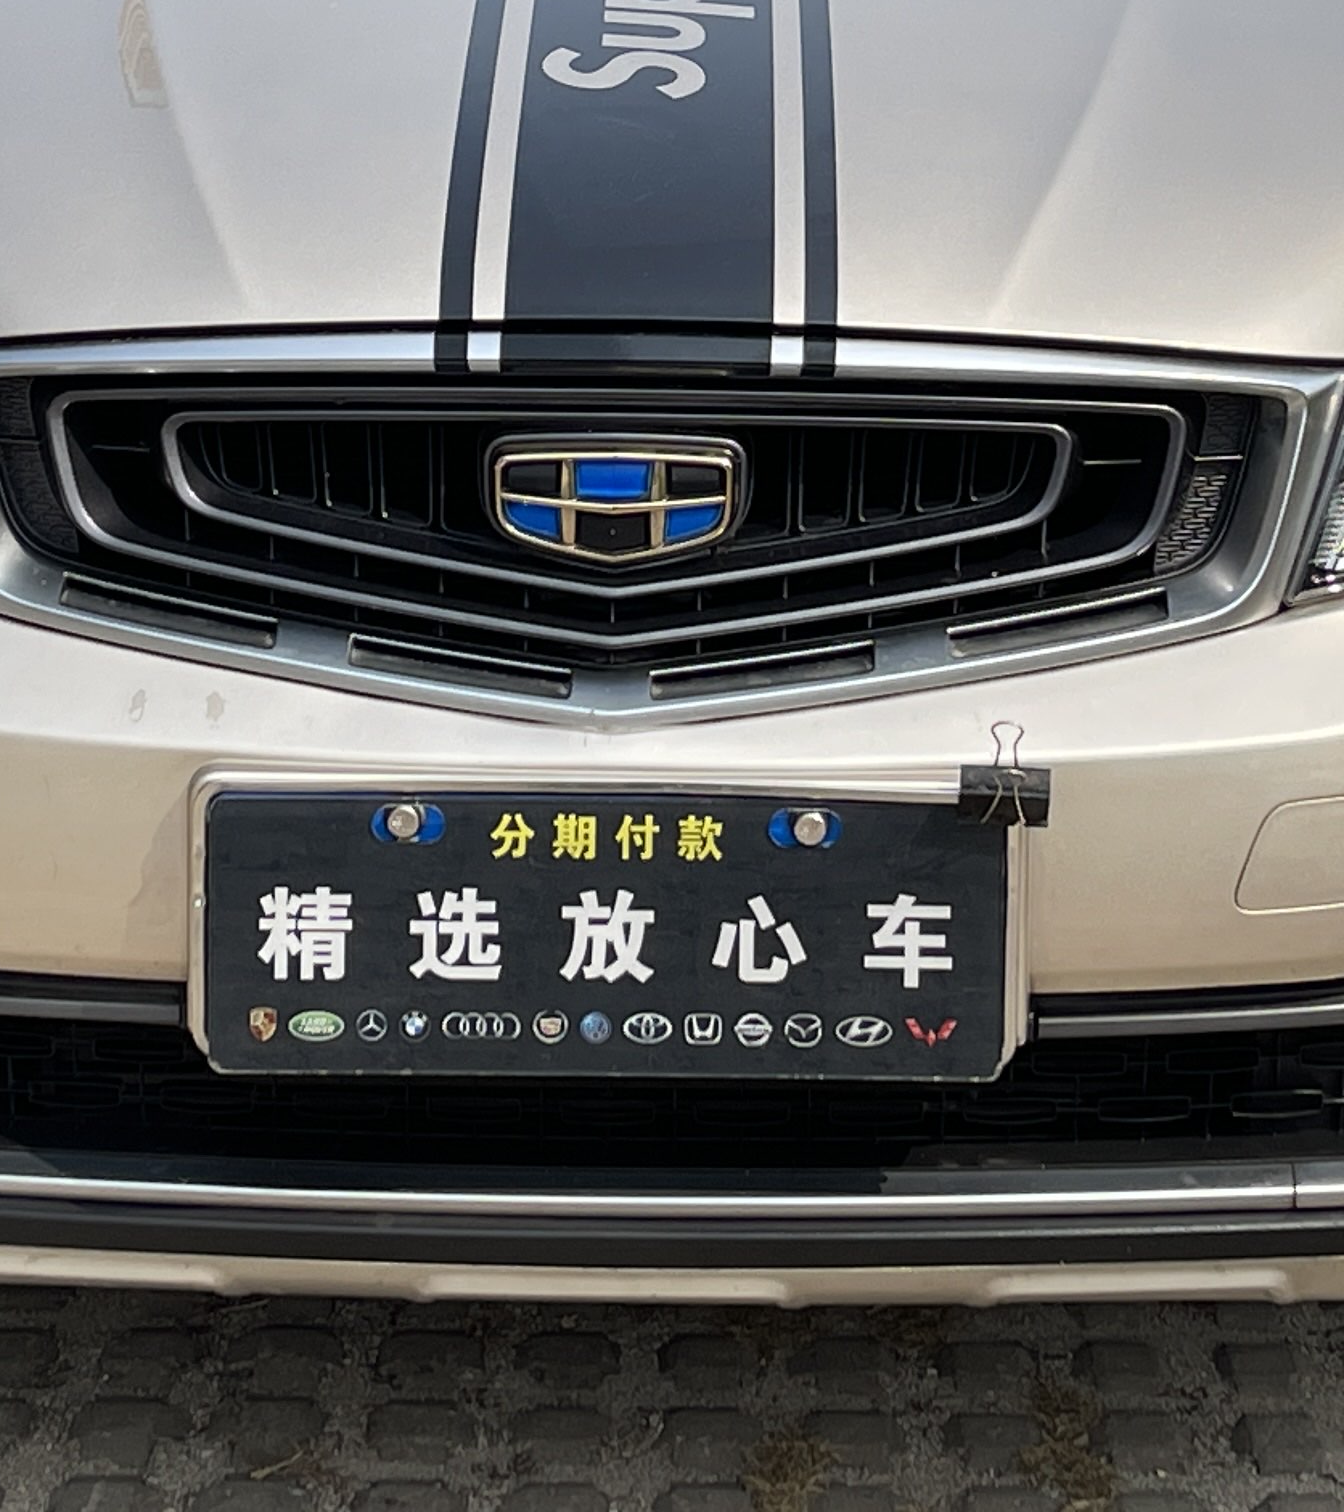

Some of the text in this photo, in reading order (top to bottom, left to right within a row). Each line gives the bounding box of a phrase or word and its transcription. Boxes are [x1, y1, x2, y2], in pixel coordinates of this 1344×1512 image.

[490, 813, 724, 862] 分期付款
[257, 886, 953, 988] 精选放心车
